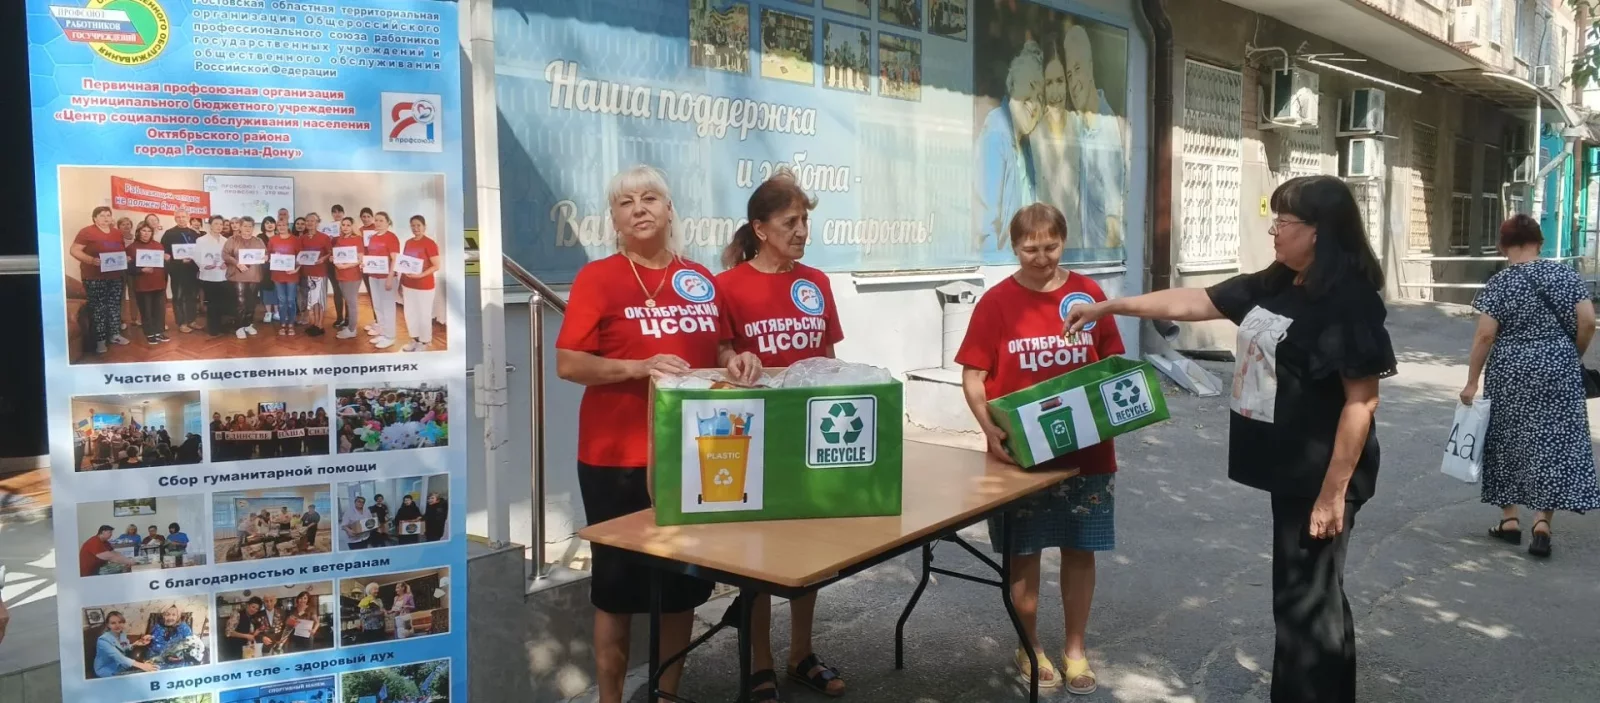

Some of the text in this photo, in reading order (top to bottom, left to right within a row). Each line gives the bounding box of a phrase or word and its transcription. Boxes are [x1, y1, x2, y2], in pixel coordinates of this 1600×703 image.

[193, 9, 440, 33] организация Общероссийского
[272, 1, 334, 13] областная
[342, 6, 439, 20] территориальная
[65, 20, 121, 31] РАБОТНИКОВ
[194, 21, 439, 46] профессионального союза работников
[194, 36, 328, 51] государственных
[338, 43, 424, 57] учреждений
[195, 48, 440, 70] общественного обслуживания
[196, 61, 337, 77] Российской Федерации
[83, 79, 344, 100] Первичная профсоюзная организация
[72, 96, 355, 115] муниципального бюджетного учреждения
[544, 59, 817, 142] Наша поддержка
[111, 111, 199, 124] социального
[204, 115, 299, 128] обслуживания
[303, 120, 370, 130] населения
[148, 128, 290, 143] Октябрьского района
[135, 144, 182, 156] города
[736, 158, 753, 188] и
[822, 211, 934, 255] старость!
[624, 302, 719, 319] ОКТЯБРЬСКИЙ
[640, 316, 716, 338] ЦСОН
[758, 331, 823, 354] ЦСОН
[1019, 346, 1087, 372] ЦСОН
[104, 363, 418, 384] Участие в общественных мероприятиях
[1115, 404, 1149, 421] RECYCLE
[706, 451, 741, 460] PLASTIC
[816, 447, 866, 463] RECYCLE
[158, 462, 377, 487] Сбор гуманитарной помощи
[149, 557, 390, 590] С благодарностью к ветеранам
[150, 681, 160, 691] В
[166, 671, 241, 690] здоровом
[247, 666, 280, 678] теле
[295, 653, 366, 672] здоровый
[370, 649, 395, 663] дух
